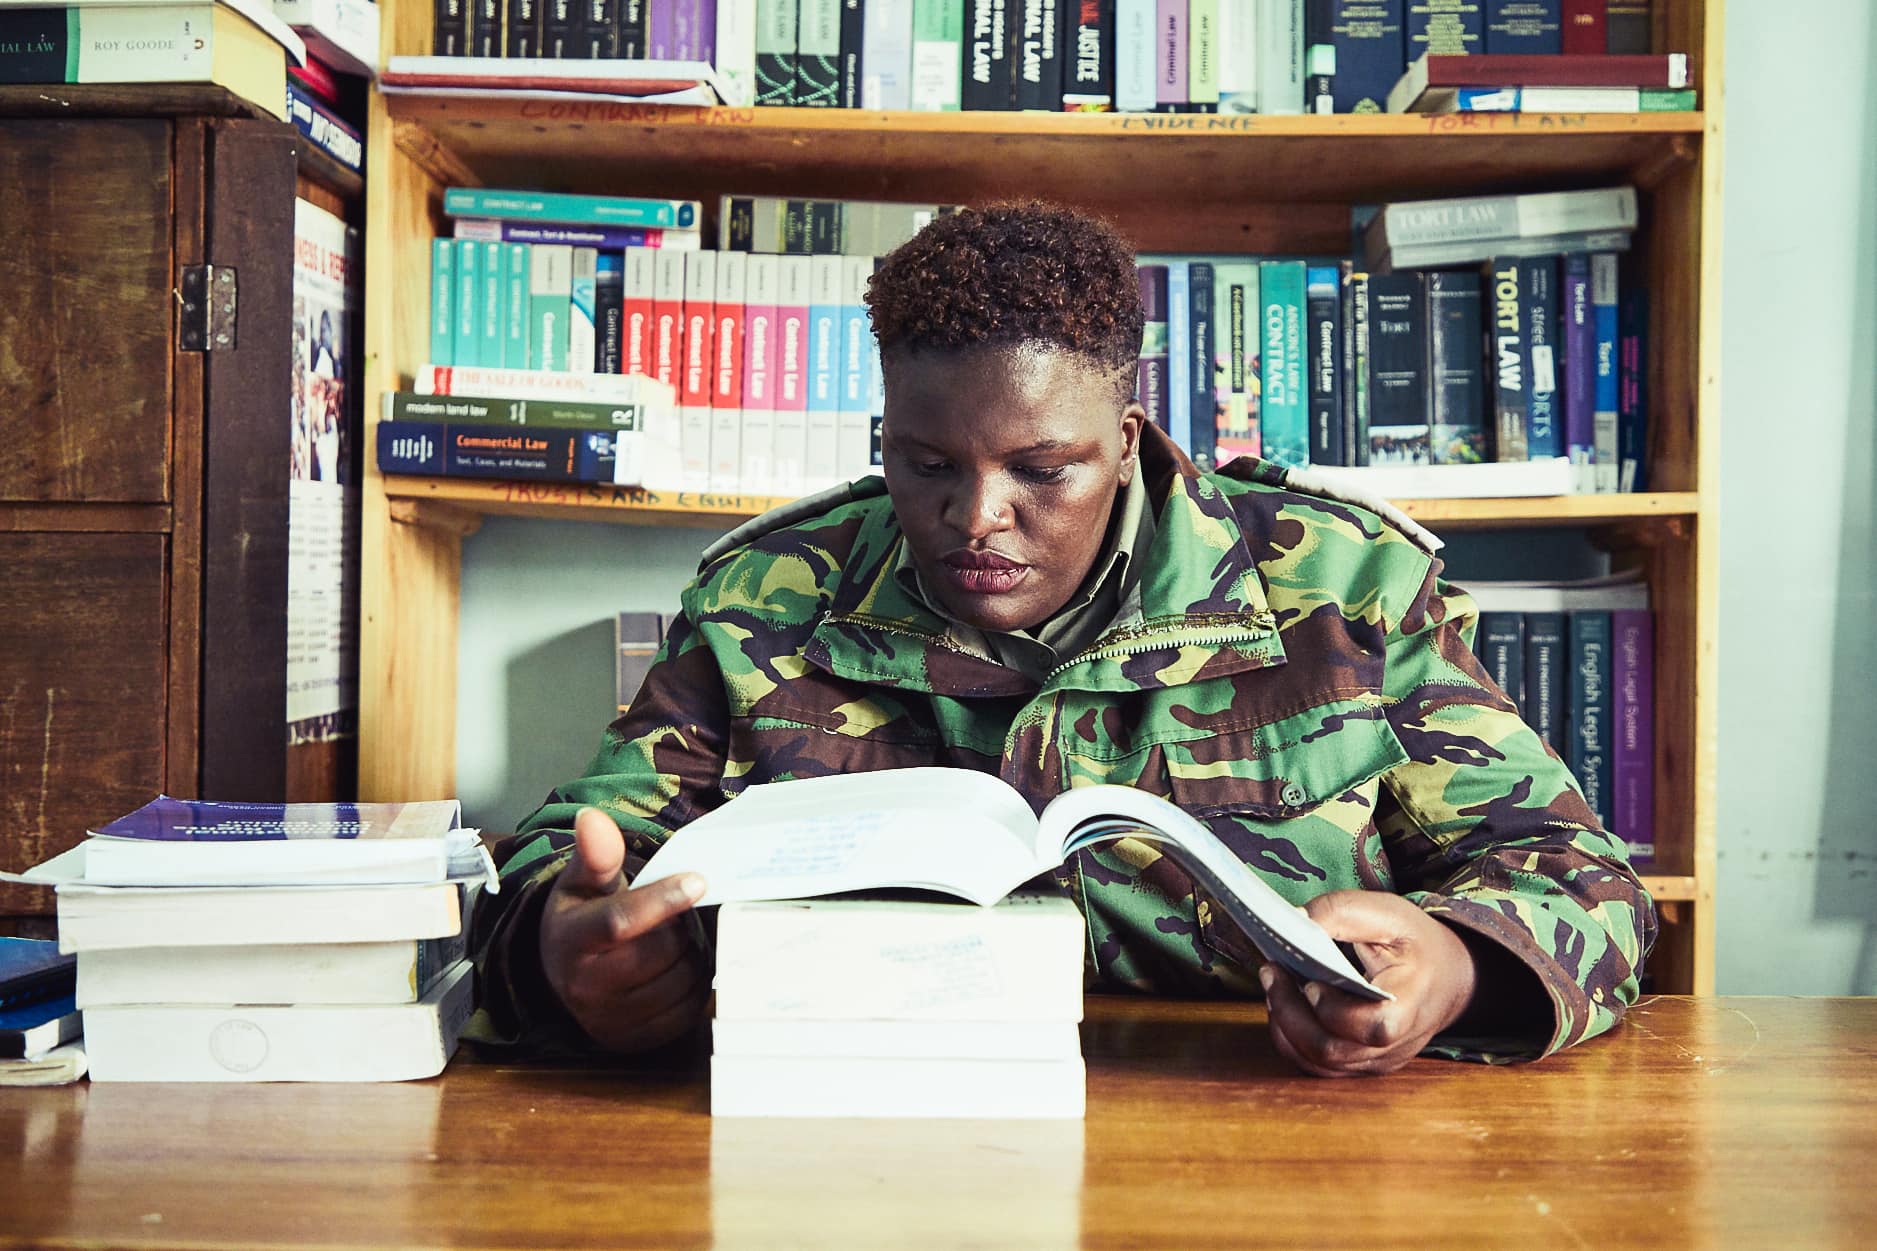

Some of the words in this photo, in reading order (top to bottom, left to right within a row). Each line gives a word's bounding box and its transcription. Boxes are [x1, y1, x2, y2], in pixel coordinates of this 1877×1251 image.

[94, 40, 121, 51] ROY
[126, 39, 175, 50] GOODE
[1166, 15, 1177, 37] Law
[28, 42, 54, 52] LAW
[973, 41, 991, 83] LAW
[1023, 41, 1041, 83] LAW
[1077, 24, 1100, 82] JUSTICE
[1166, 38, 1177, 86] Criminal
[520, 101, 673, 123] CONTRACT
[1120, 115, 1260, 131] EVIDENCE
[1427, 114, 1500, 132] TORT
[1455, 203, 1497, 223] LAW
[1495, 266, 1520, 332] TORT
[1574, 282, 1587, 303] Tort
[605, 308, 619, 353] Contract
[1530, 306, 1546, 344] stree
[1574, 303, 1587, 325] Law
[542, 312, 556, 357] Contract
[629, 312, 644, 363] Contract
[659, 315, 673, 366] Contract
[689, 315, 704, 366] Contract
[720, 317, 735, 369] Contract
[752, 316, 768, 369] Contract
[784, 317, 801, 371] Contract
[818, 317, 832, 370] Contract
[848, 317, 862, 371] Contract
[1320, 320, 1334, 368] Contract
[1267, 304, 1285, 406] CONTRACT
[1498, 336, 1522, 392] LAW
[1598, 341, 1613, 377] Torts
[688, 367, 702, 394] Law
[719, 369, 733, 395] Law
[751, 371, 766, 398] Law
[783, 373, 799, 400] Law
[817, 373, 830, 399] Law
[847, 373, 861, 399] Law
[1287, 362, 1299, 388] LAW
[1320, 369, 1334, 392] Law
[406, 402, 446, 415] modern
[446, 403, 468, 416] land
[469, 404, 488, 417] law
[1531, 388, 1551, 438] ORTS
[456, 434, 522, 450] Commercial
[525, 437, 549, 450] Law
[456, 457, 472, 465] Text,
[475, 457, 496, 467] Cases,
[499, 458, 513, 467] and
[515, 459, 547, 469] Materials
[1623, 627, 1640, 667] English
[1580, 643, 1602, 703] English
[1624, 671, 1639, 703] Legal
[1581, 706, 1602, 751] Legal
[1624, 705, 1639, 750] System
